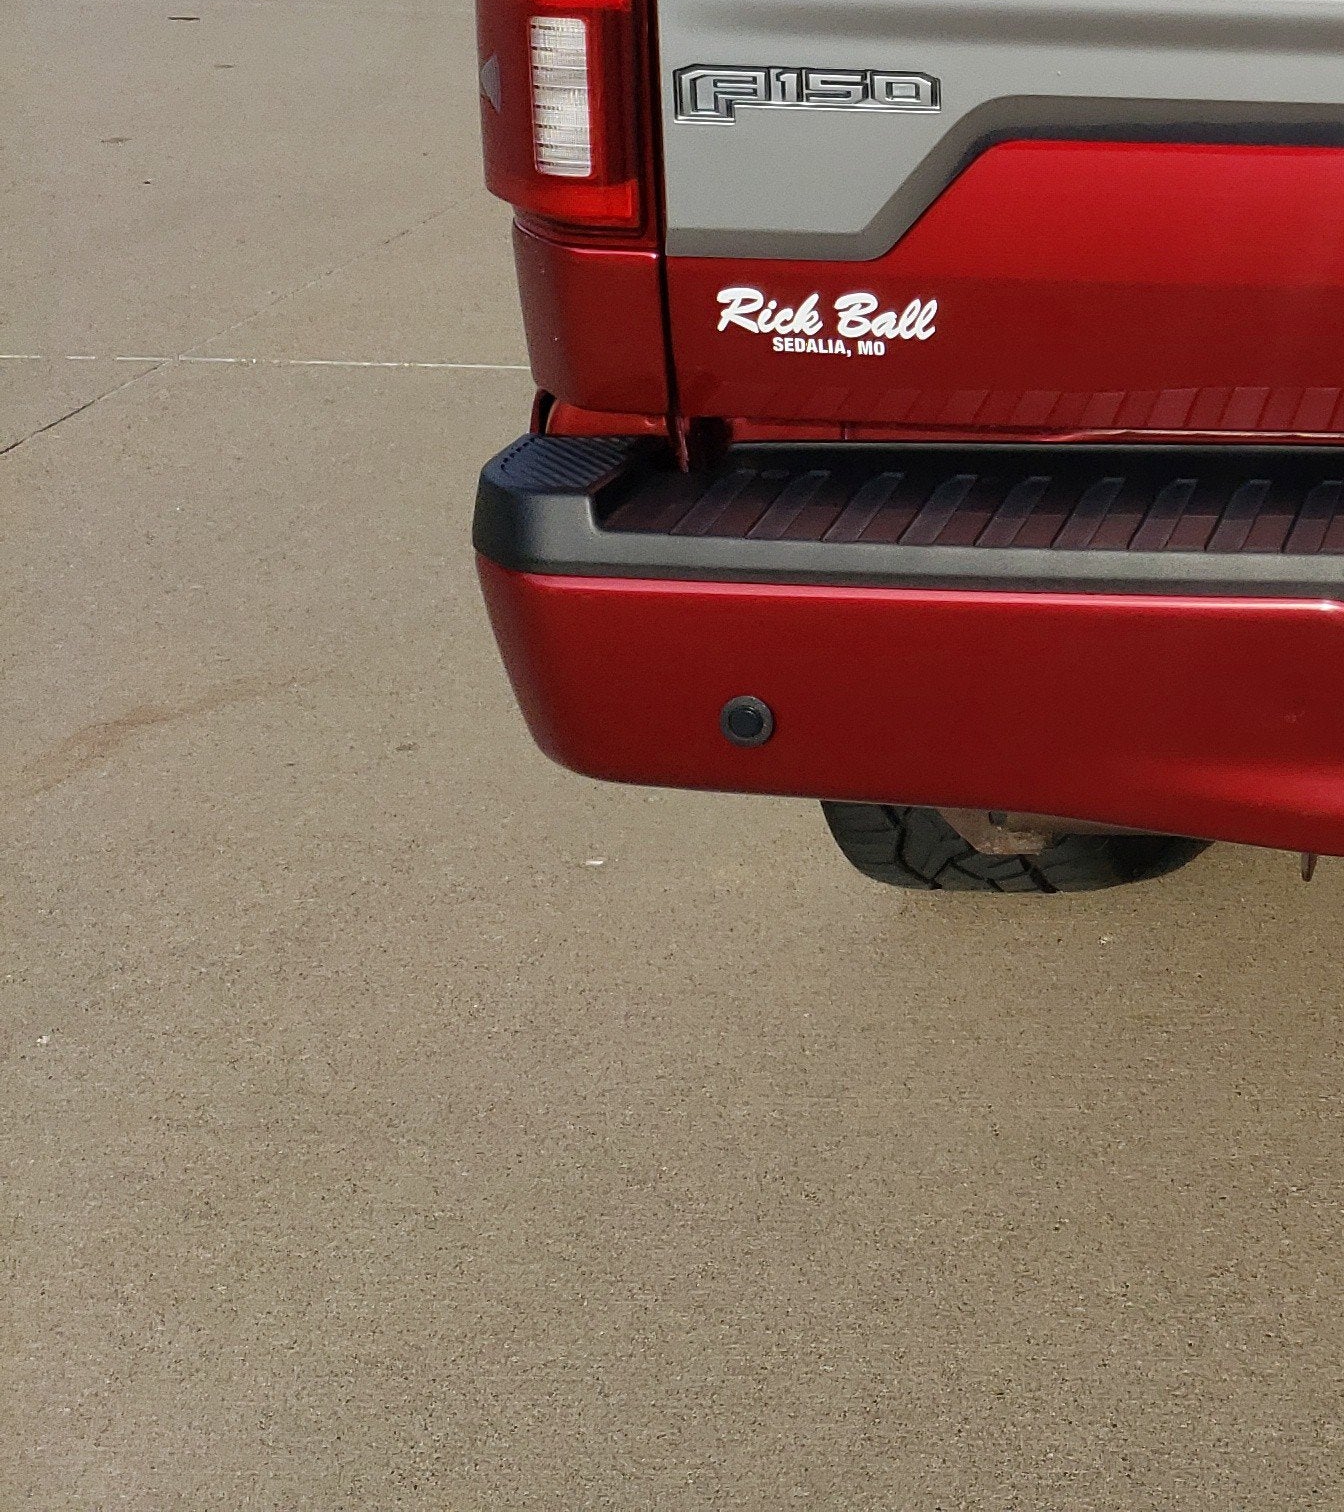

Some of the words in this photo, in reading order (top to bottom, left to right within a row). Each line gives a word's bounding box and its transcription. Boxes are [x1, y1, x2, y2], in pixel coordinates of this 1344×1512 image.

[717, 287, 824, 336] Rick
[833, 292, 938, 341] Ball
[772, 337, 852, 357] SEDALIA,
[858, 340, 885, 356] MO
